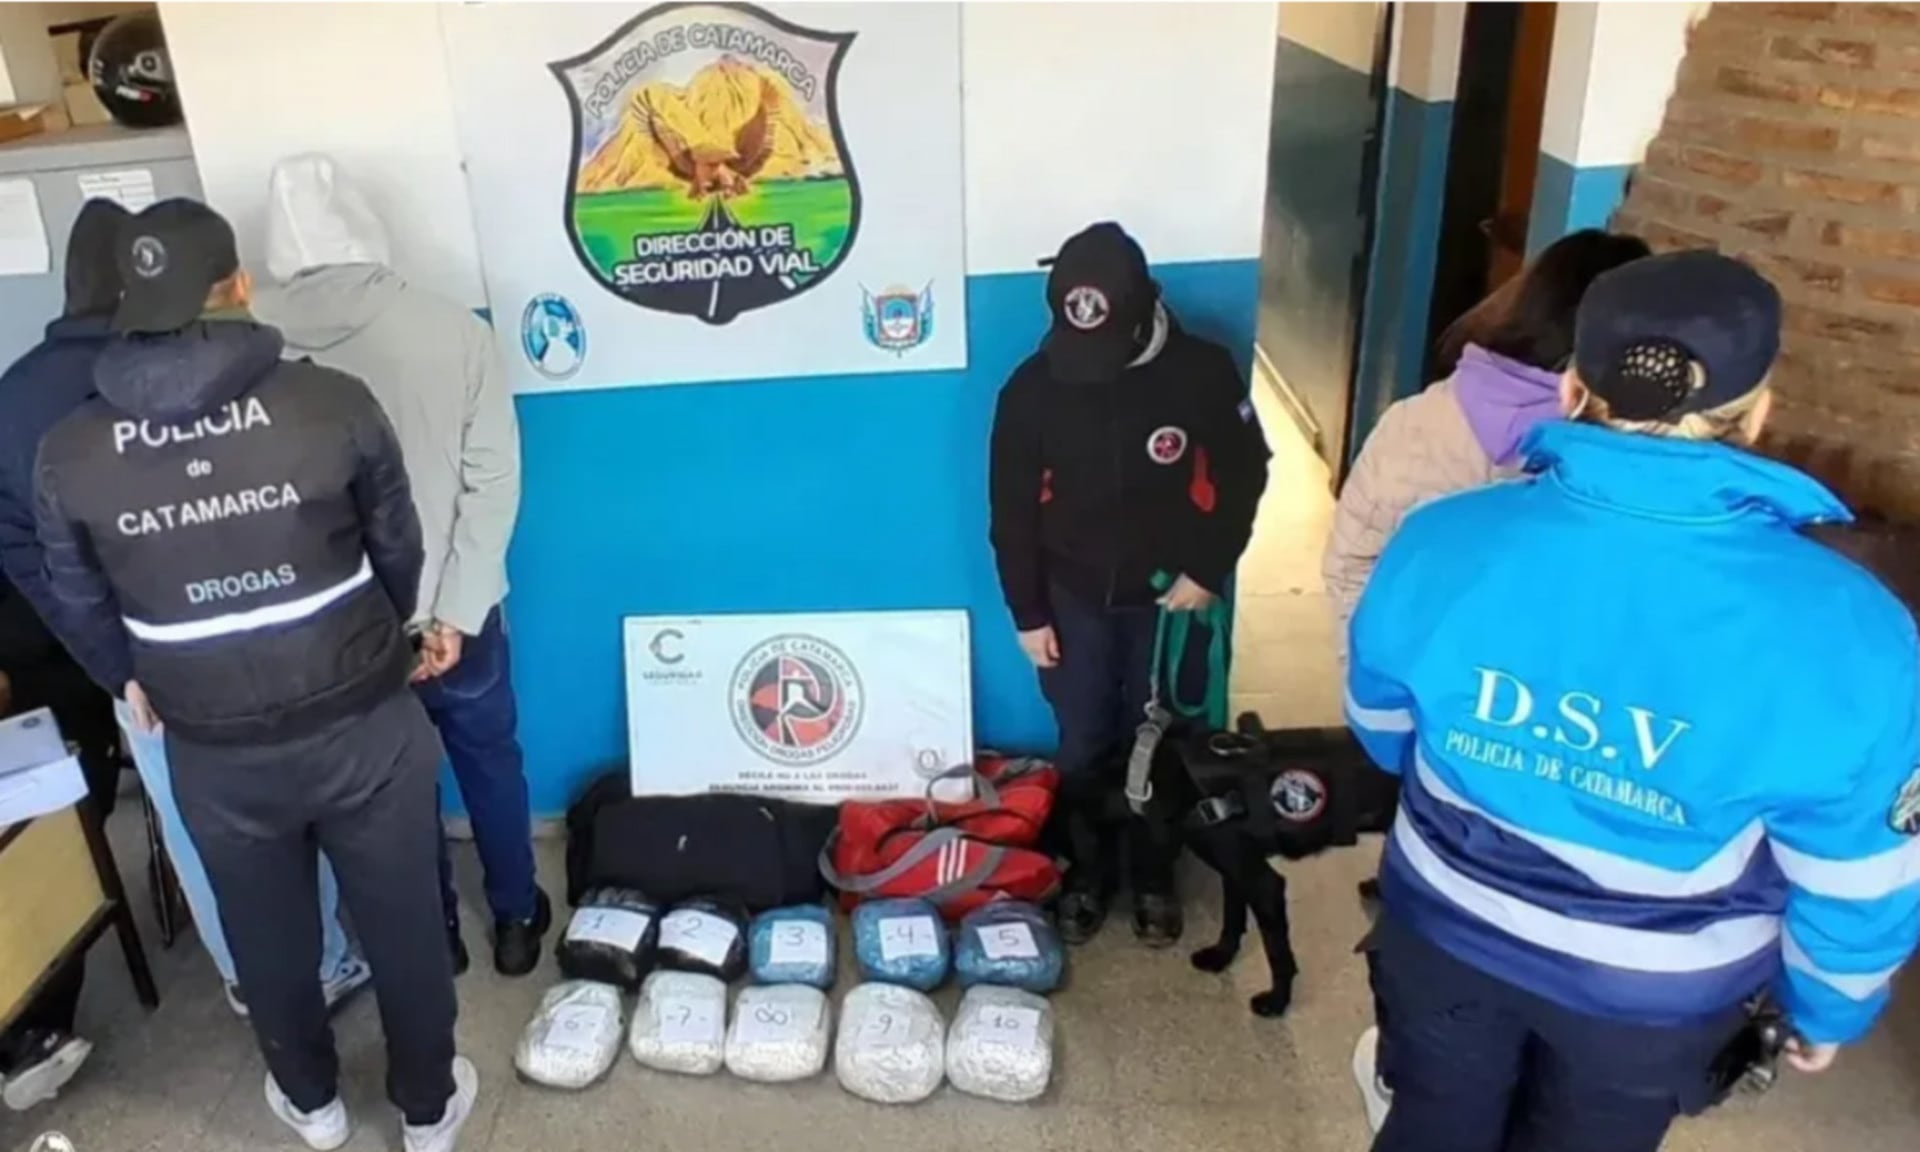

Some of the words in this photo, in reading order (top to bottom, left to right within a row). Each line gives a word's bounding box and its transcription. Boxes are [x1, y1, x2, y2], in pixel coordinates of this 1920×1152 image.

[585, 41, 656, 118] POLICIA
[654, 26, 687, 52] DE
[687, 22, 817, 101] CATAMARCA
[636, 228, 756, 257] DIRECCIÓN
[760, 226, 792, 247] DE
[614, 255, 754, 286] SEGURIDAD
[759, 251, 820, 275] VIAL
[186, 458, 213, 478] de
[117, 482, 301, 535] CATAMARCA
[185, 563, 297, 604] DROGAS
[1472, 666, 1692, 770] D.S.V
[1446, 729, 1524, 772] POLICIA
[1535, 752, 1564, 782] DE
[1569, 765, 1687, 826] CATAMARCA
